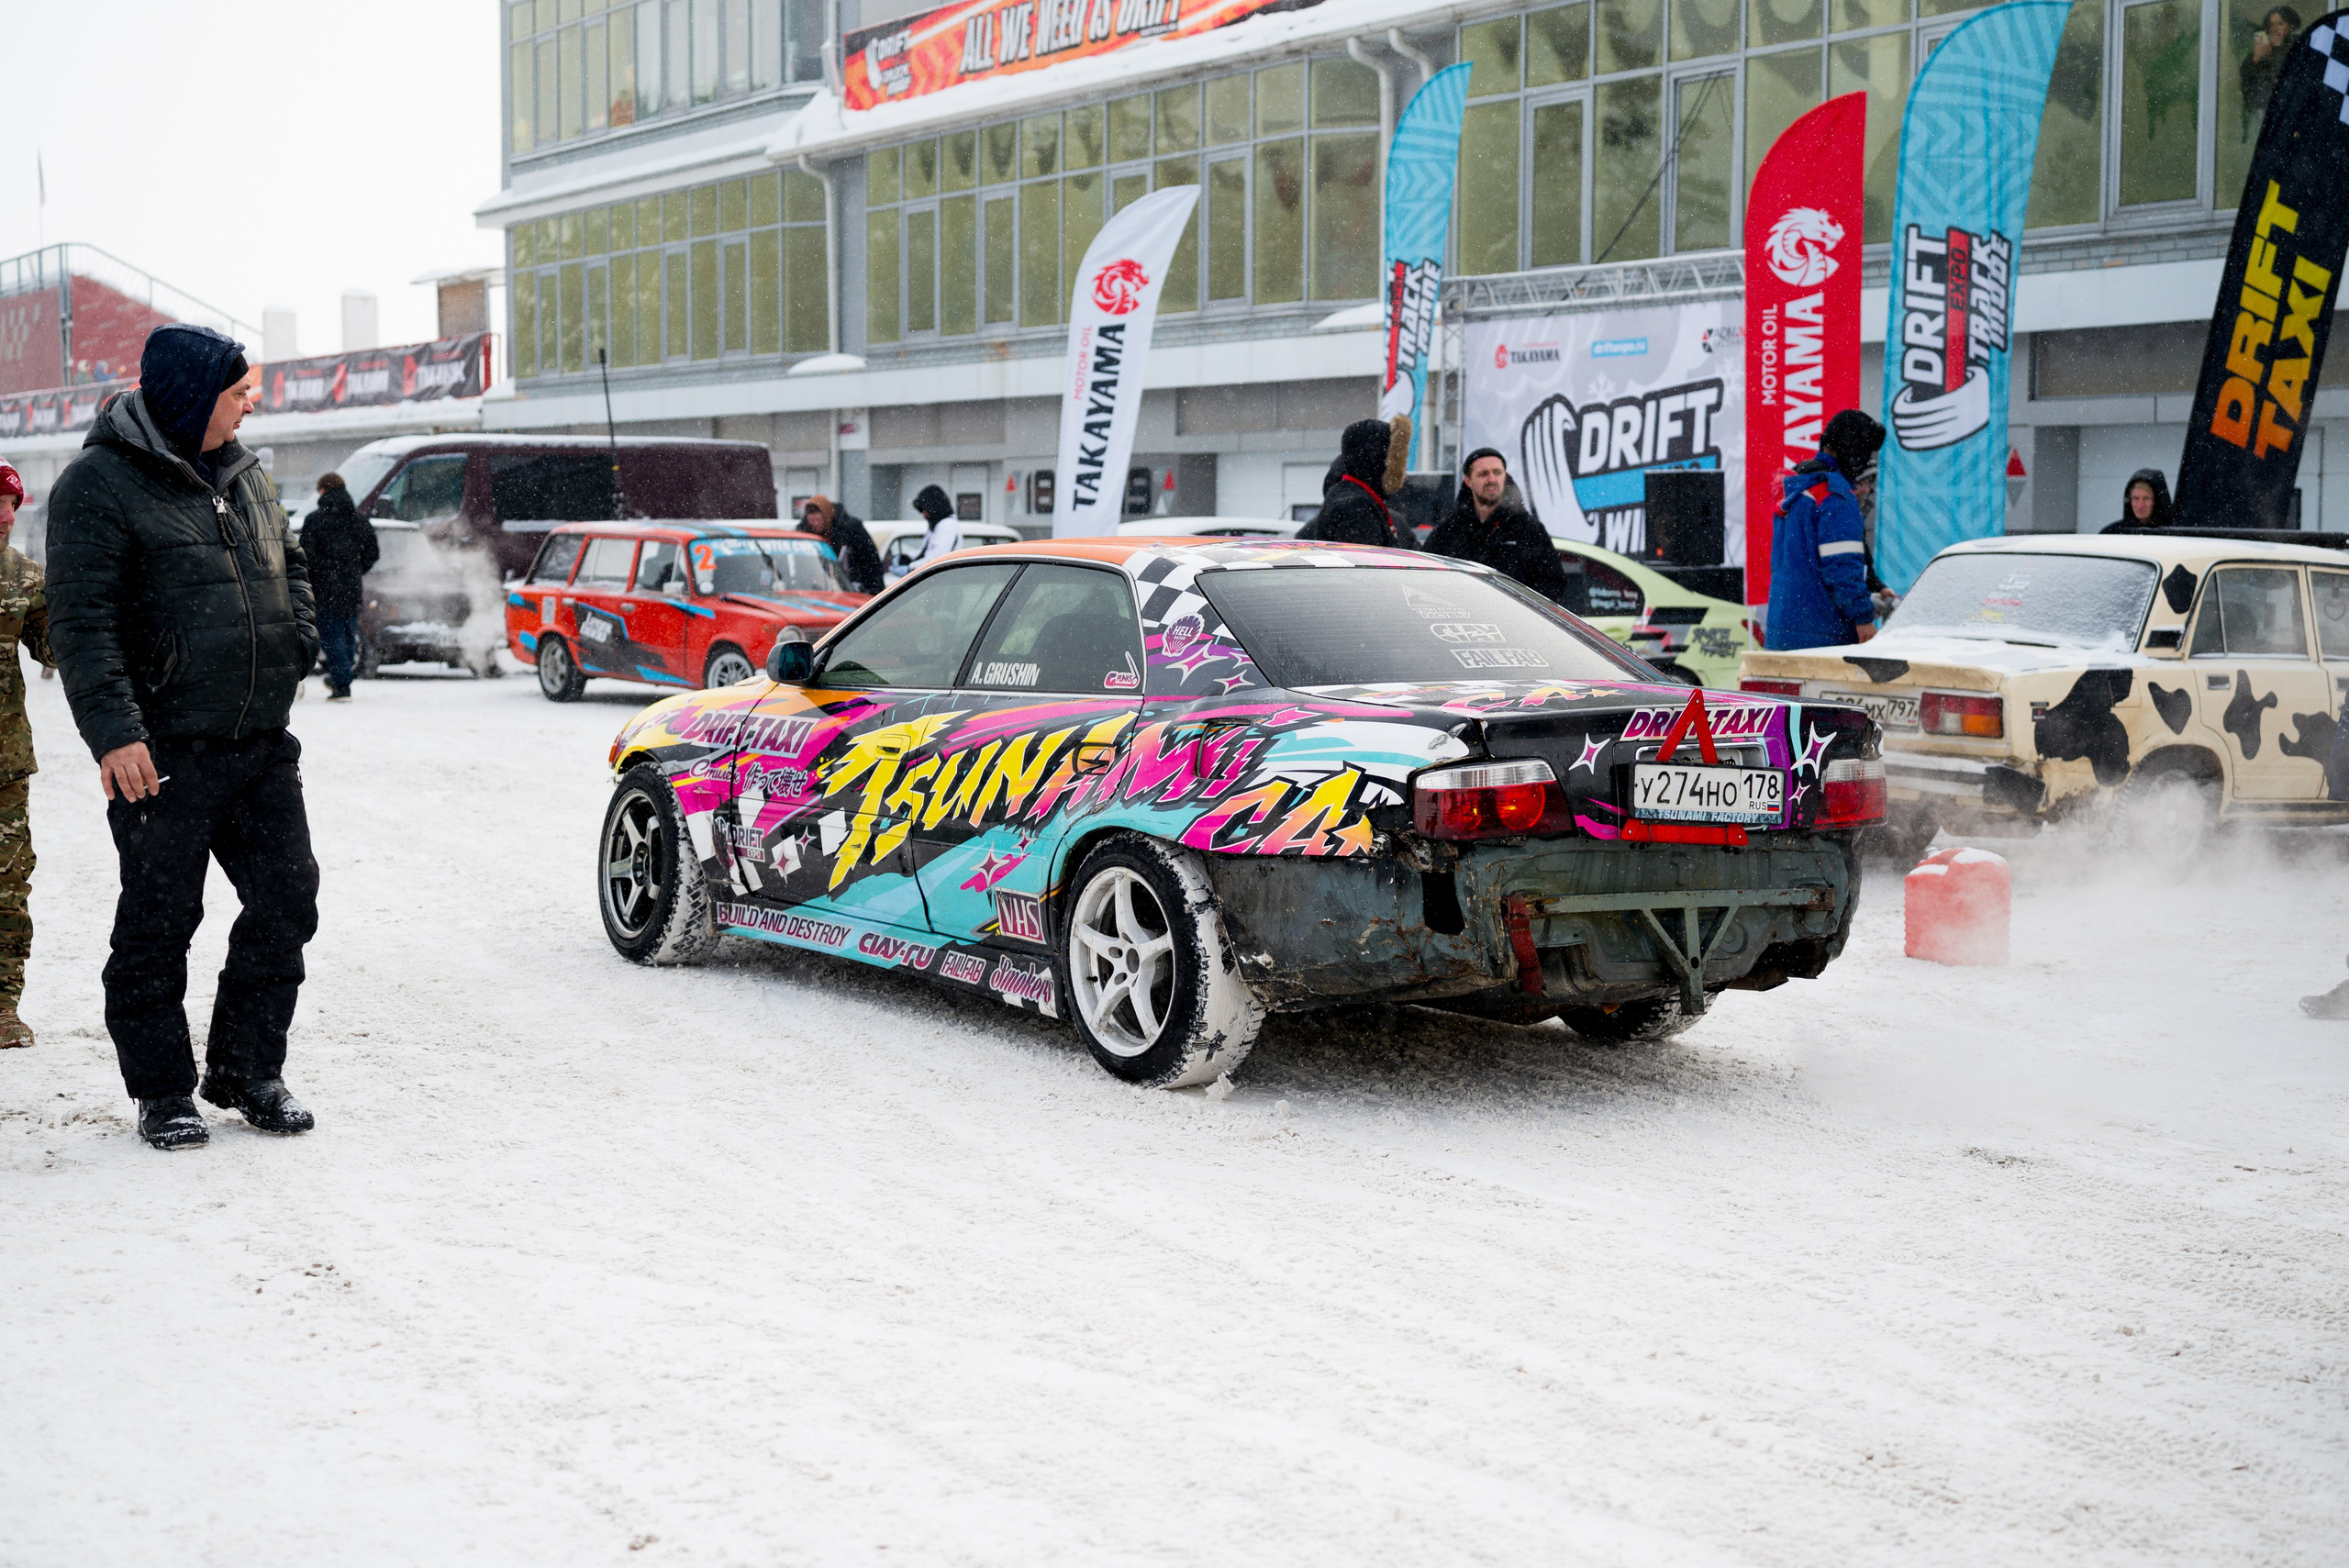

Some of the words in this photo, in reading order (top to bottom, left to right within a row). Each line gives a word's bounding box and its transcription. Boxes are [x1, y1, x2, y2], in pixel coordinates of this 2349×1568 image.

[960, 12, 994, 74] ALL
[999, 3, 1033, 65] WE
[1035, 0, 1087, 56] NEED
[1089, 0, 1112, 42] IS
[1951, 249, 1967, 312] EXPO
[1968, 236, 1990, 363] TRACK
[1397, 265, 1423, 369] TRACK
[1762, 304, 1777, 336] OIL
[1903, 226, 1947, 385] DRIFT
[2210, 179, 2299, 449] DRIFT
[1074, 350, 1088, 400] MOTOR
[1081, 326, 1093, 347] OIL
[1510, 349, 1560, 363] TAKAYAMA
[1762, 338, 1777, 405] MOTOR
[2253, 254, 2332, 460] TAXI
[1784, 291, 1824, 469] AYAMA
[1073, 323, 1125, 511] TAKAYAMA
[1578, 387, 1719, 474] DRIFT
[694, 544, 717, 570] 2
[1173, 626, 1193, 637] HELL
[1625, 708, 1710, 738] DRI
[1710, 707, 1776, 736] TAXI
[1890, 700, 1915, 717] 797
[680, 712, 754, 747] DRIFT
[750, 717, 814, 754] TAXI
[743, 763, 807, 796] 作って壊せ
[820, 709, 1266, 892] TSUNAMI
[1743, 773, 1778, 799] 178
[1658, 810, 1707, 821] TSUNAMI
[1711, 812, 1760, 823] FACTORY
[1749, 801, 1767, 810] RUS
[727, 824, 763, 848] DRIFT
[747, 849, 761, 859] EXPO
[718, 904, 759, 927] BUILD
[759, 911, 787, 933] AND
[787, 917, 851, 947] DESTROY
[999, 895, 1040, 938] VHS
[991, 956, 1053, 1003] Smokers
